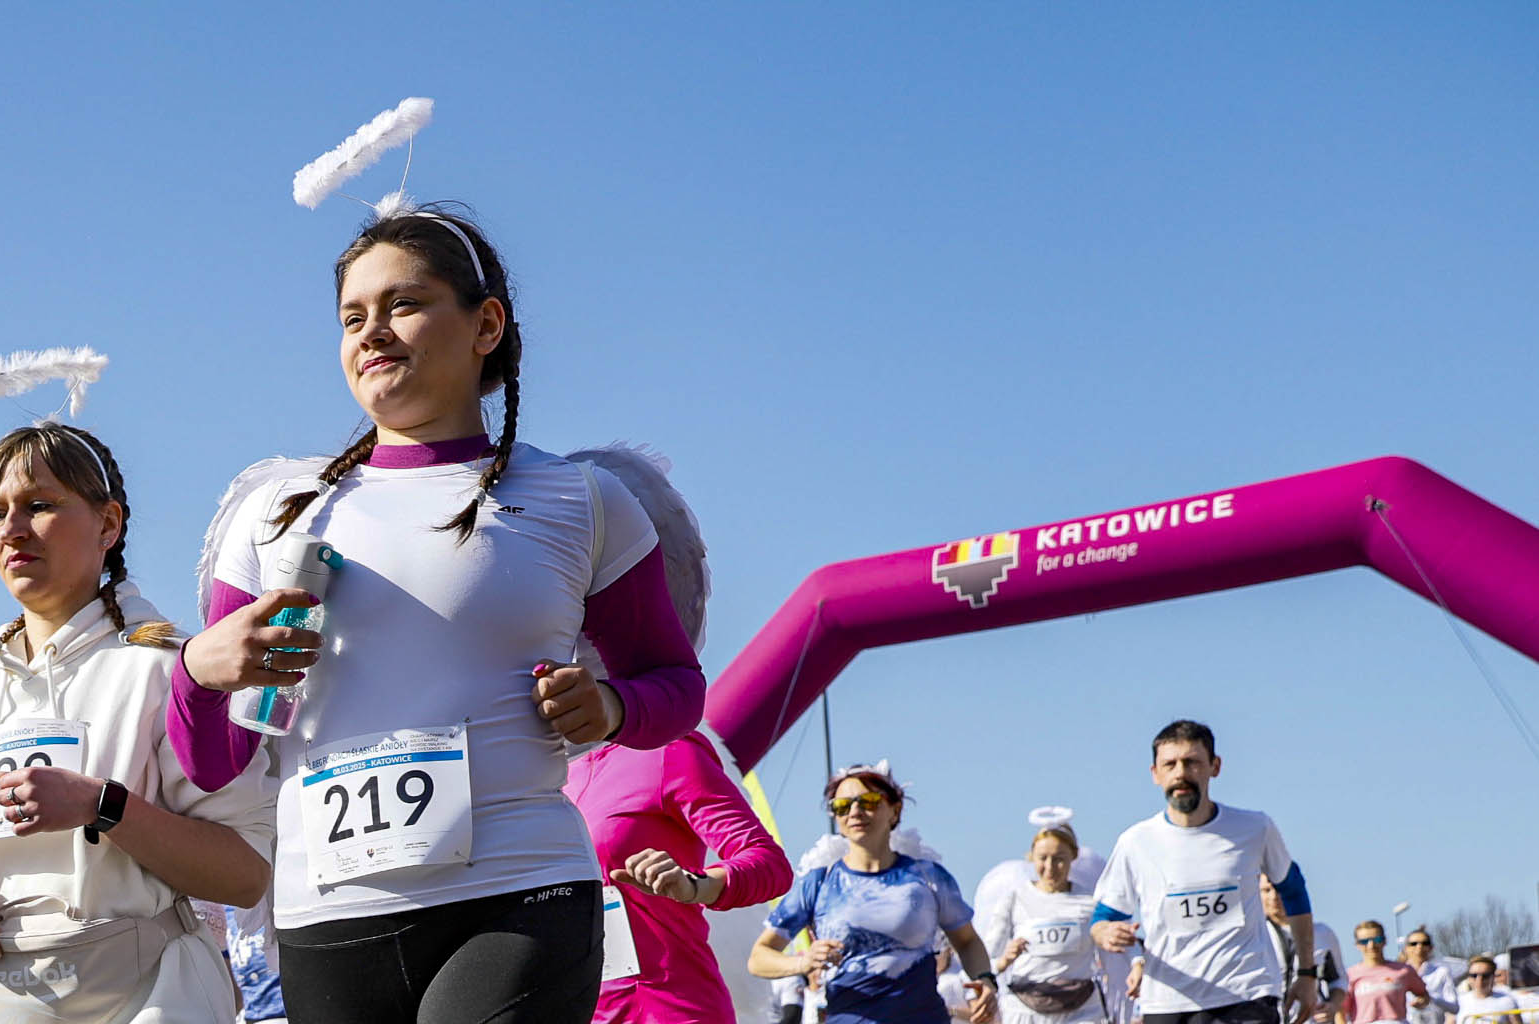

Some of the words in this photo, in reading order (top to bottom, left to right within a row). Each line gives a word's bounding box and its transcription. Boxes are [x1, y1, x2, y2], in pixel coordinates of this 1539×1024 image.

[1036, 493, 1235, 551] KATOWICE
[1036, 554, 1060, 576] for
[1063, 553, 1074, 568] a
[1077, 542, 1139, 567] change
[380, 739, 409, 753] ANIOŁY
[371, 754, 413, 767] KATOWICE
[323, 769, 435, 844] 219
[1179, 894, 1228, 919] 156
[1037, 927, 1070, 944] 107
